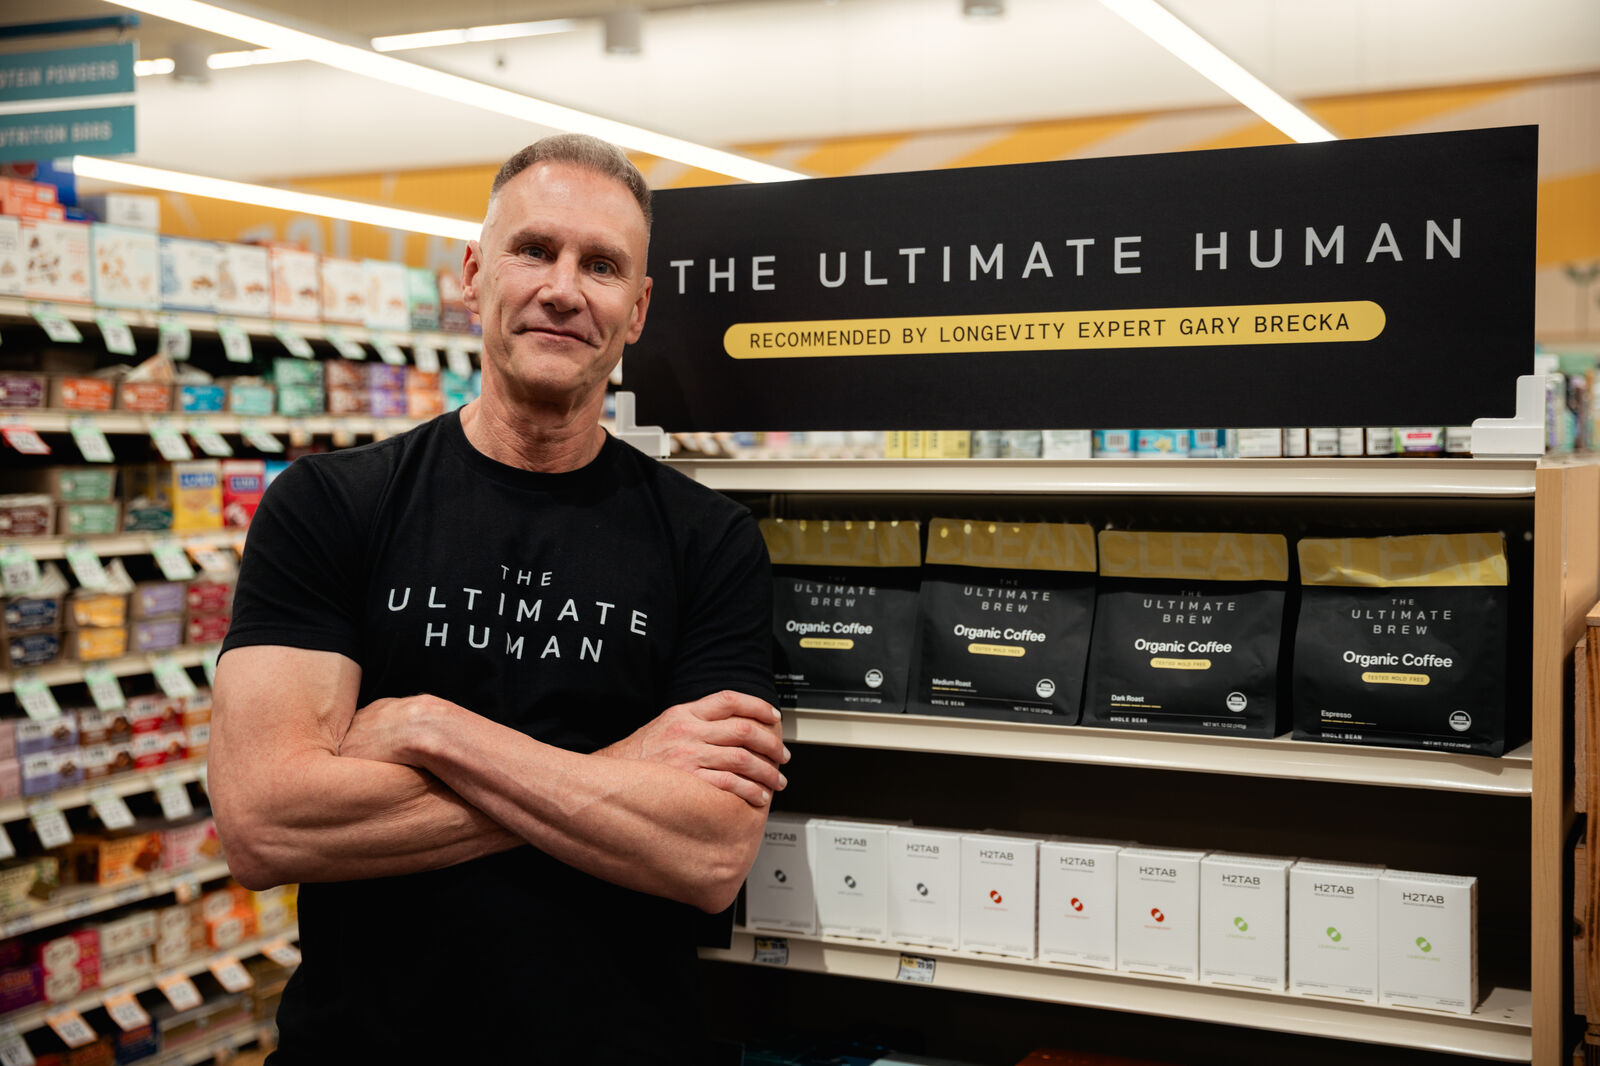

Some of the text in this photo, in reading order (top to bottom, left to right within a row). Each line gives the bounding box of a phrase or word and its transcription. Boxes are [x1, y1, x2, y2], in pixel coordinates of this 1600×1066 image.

[670, 217, 1463, 294] THE ULTIMATE HUMAN
[749, 312, 1350, 349] RECOMMENDED BY LONGEVITY EXPERT GARY BRECKA
[926, 519, 1097, 569] CLEAN
[1099, 530, 1288, 576] CLEAN
[1298, 533, 1507, 582] CLEAN
[500, 564, 553, 586] THE
[794, 583, 877, 595] ULTIMATE
[964, 586, 1050, 602] ULTIMATE
[811, 597, 856, 607] BREW
[981, 601, 1028, 613] BREW
[1143, 599, 1236, 611] ULTIMATE
[387, 586, 649, 636] ULTIMATE
[1351, 609, 1453, 621] ULTIMATE
[1162, 614, 1213, 624] BREW
[786, 620, 874, 635] Organic Coffee
[954, 623, 1046, 642] Organic Coffee
[1372, 625, 1428, 635] BREW
[424, 622, 604, 663] HUMAN
[1134, 638, 1233, 654] Organic Coffee
[1343, 650, 1453, 668] Organic Coffee
[932, 677, 972, 688] Medium Roast
[1111, 694, 1145, 703] Dark Roast
[1321, 709, 1352, 720] Espresso
[764, 832, 797, 842] H2TAB
[834, 836, 867, 847] H2TAB
[907, 843, 940, 854] H2TAB
[979, 850, 1014, 861] H2TAB
[1060, 856, 1095, 867] H2TAB
[1139, 866, 1177, 878] H2TAB
[1222, 874, 1261, 885] H2TAB
[1313, 883, 1354, 895] H2TAB
[1402, 892, 1445, 905] H2TAB
